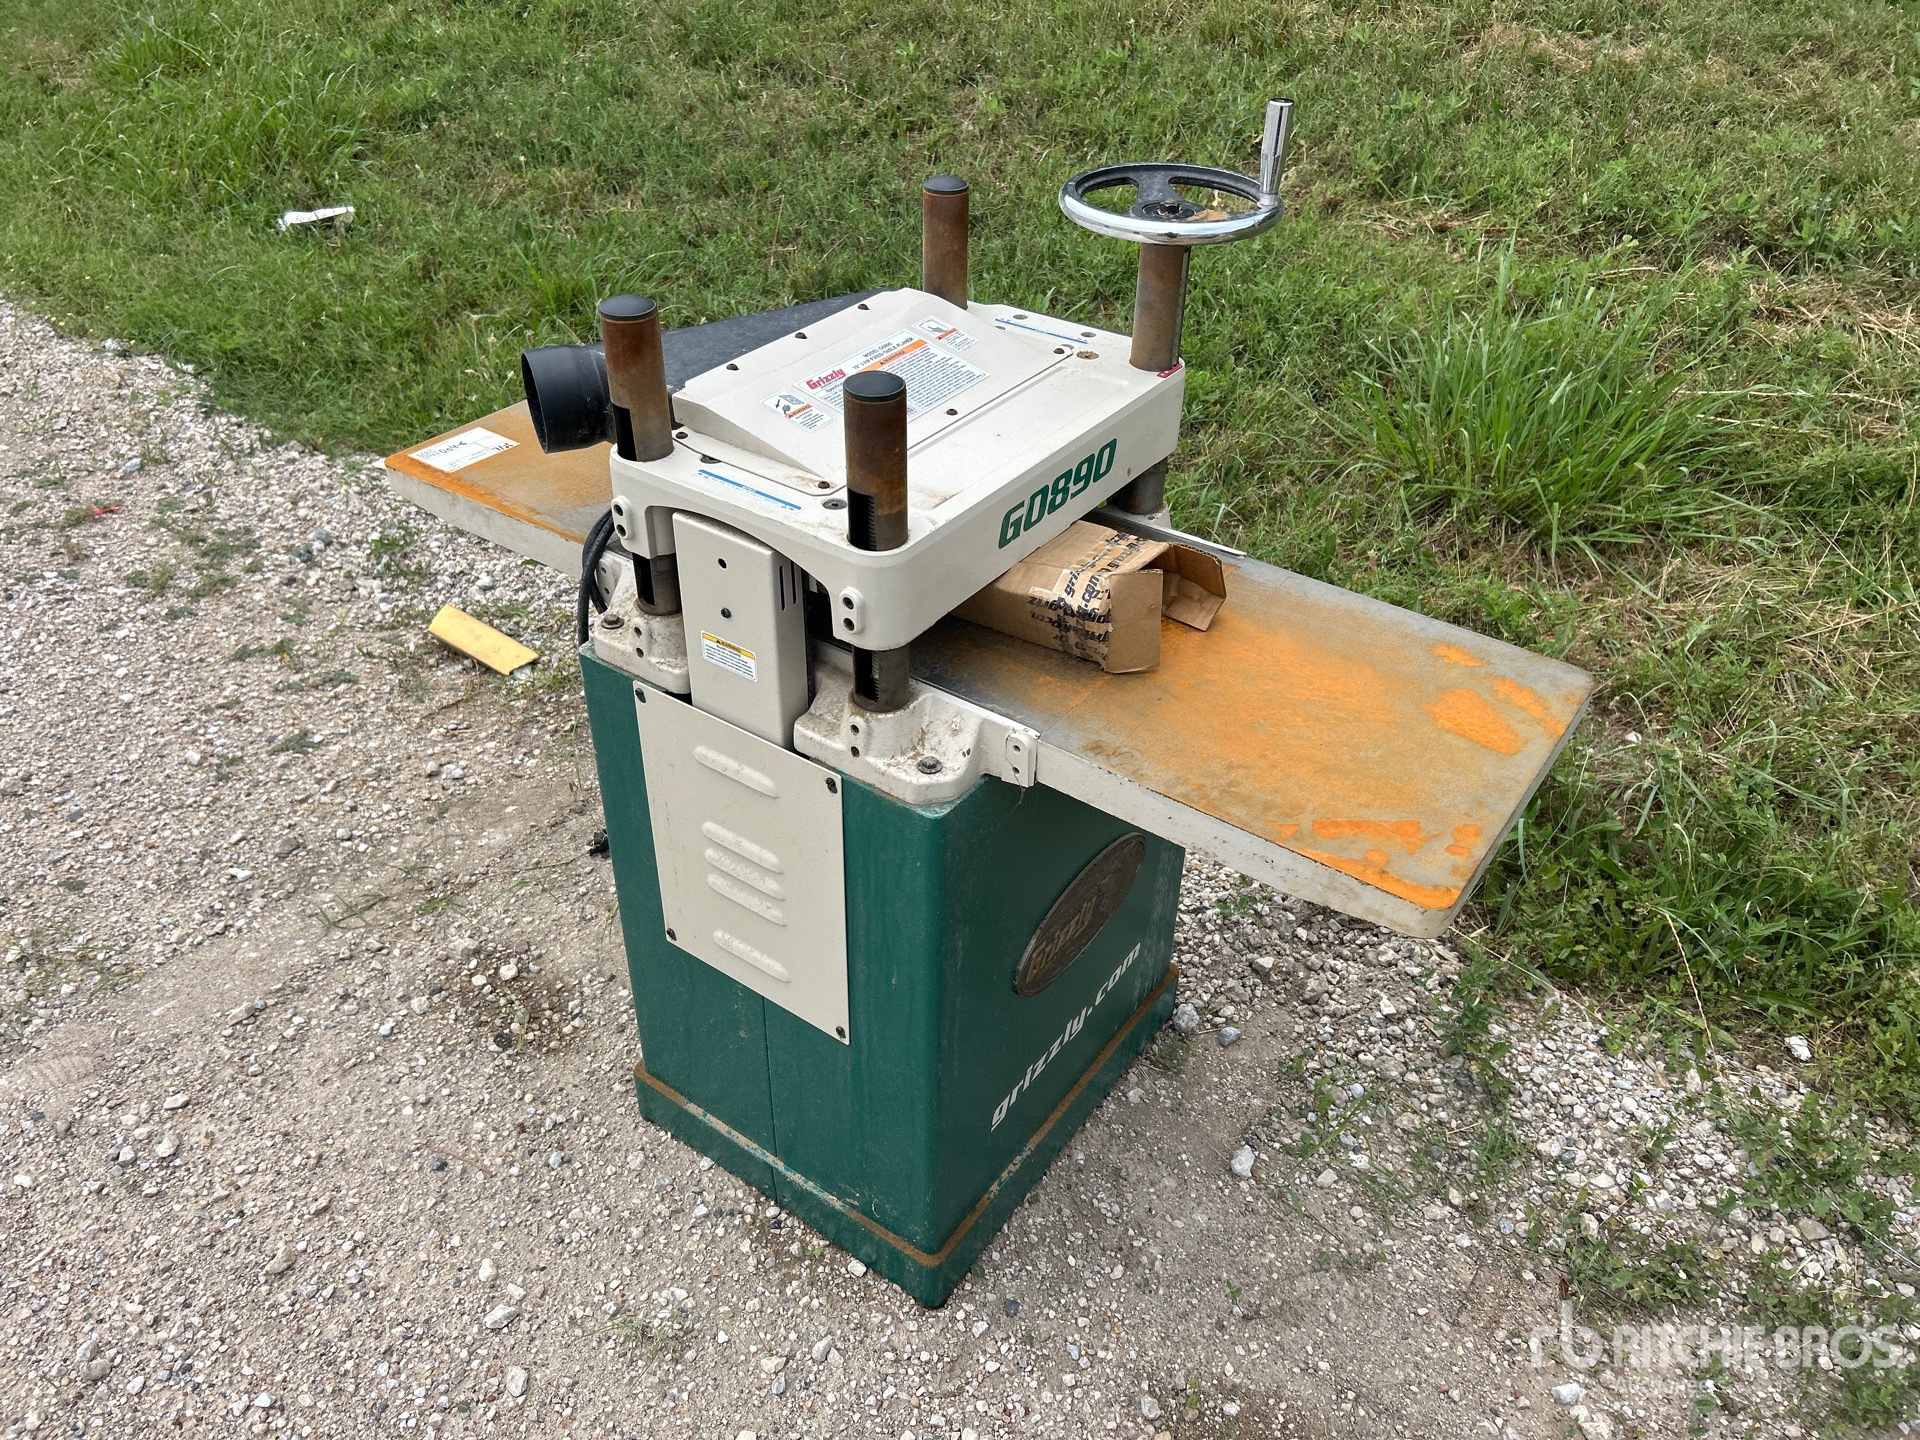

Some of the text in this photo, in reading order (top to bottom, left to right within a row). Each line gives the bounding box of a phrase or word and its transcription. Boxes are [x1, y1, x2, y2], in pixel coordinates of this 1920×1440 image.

[806, 369, 847, 390] Grizzly
[998, 438, 1117, 549] G0890
[990, 942, 1141, 1132] grizzly.com
